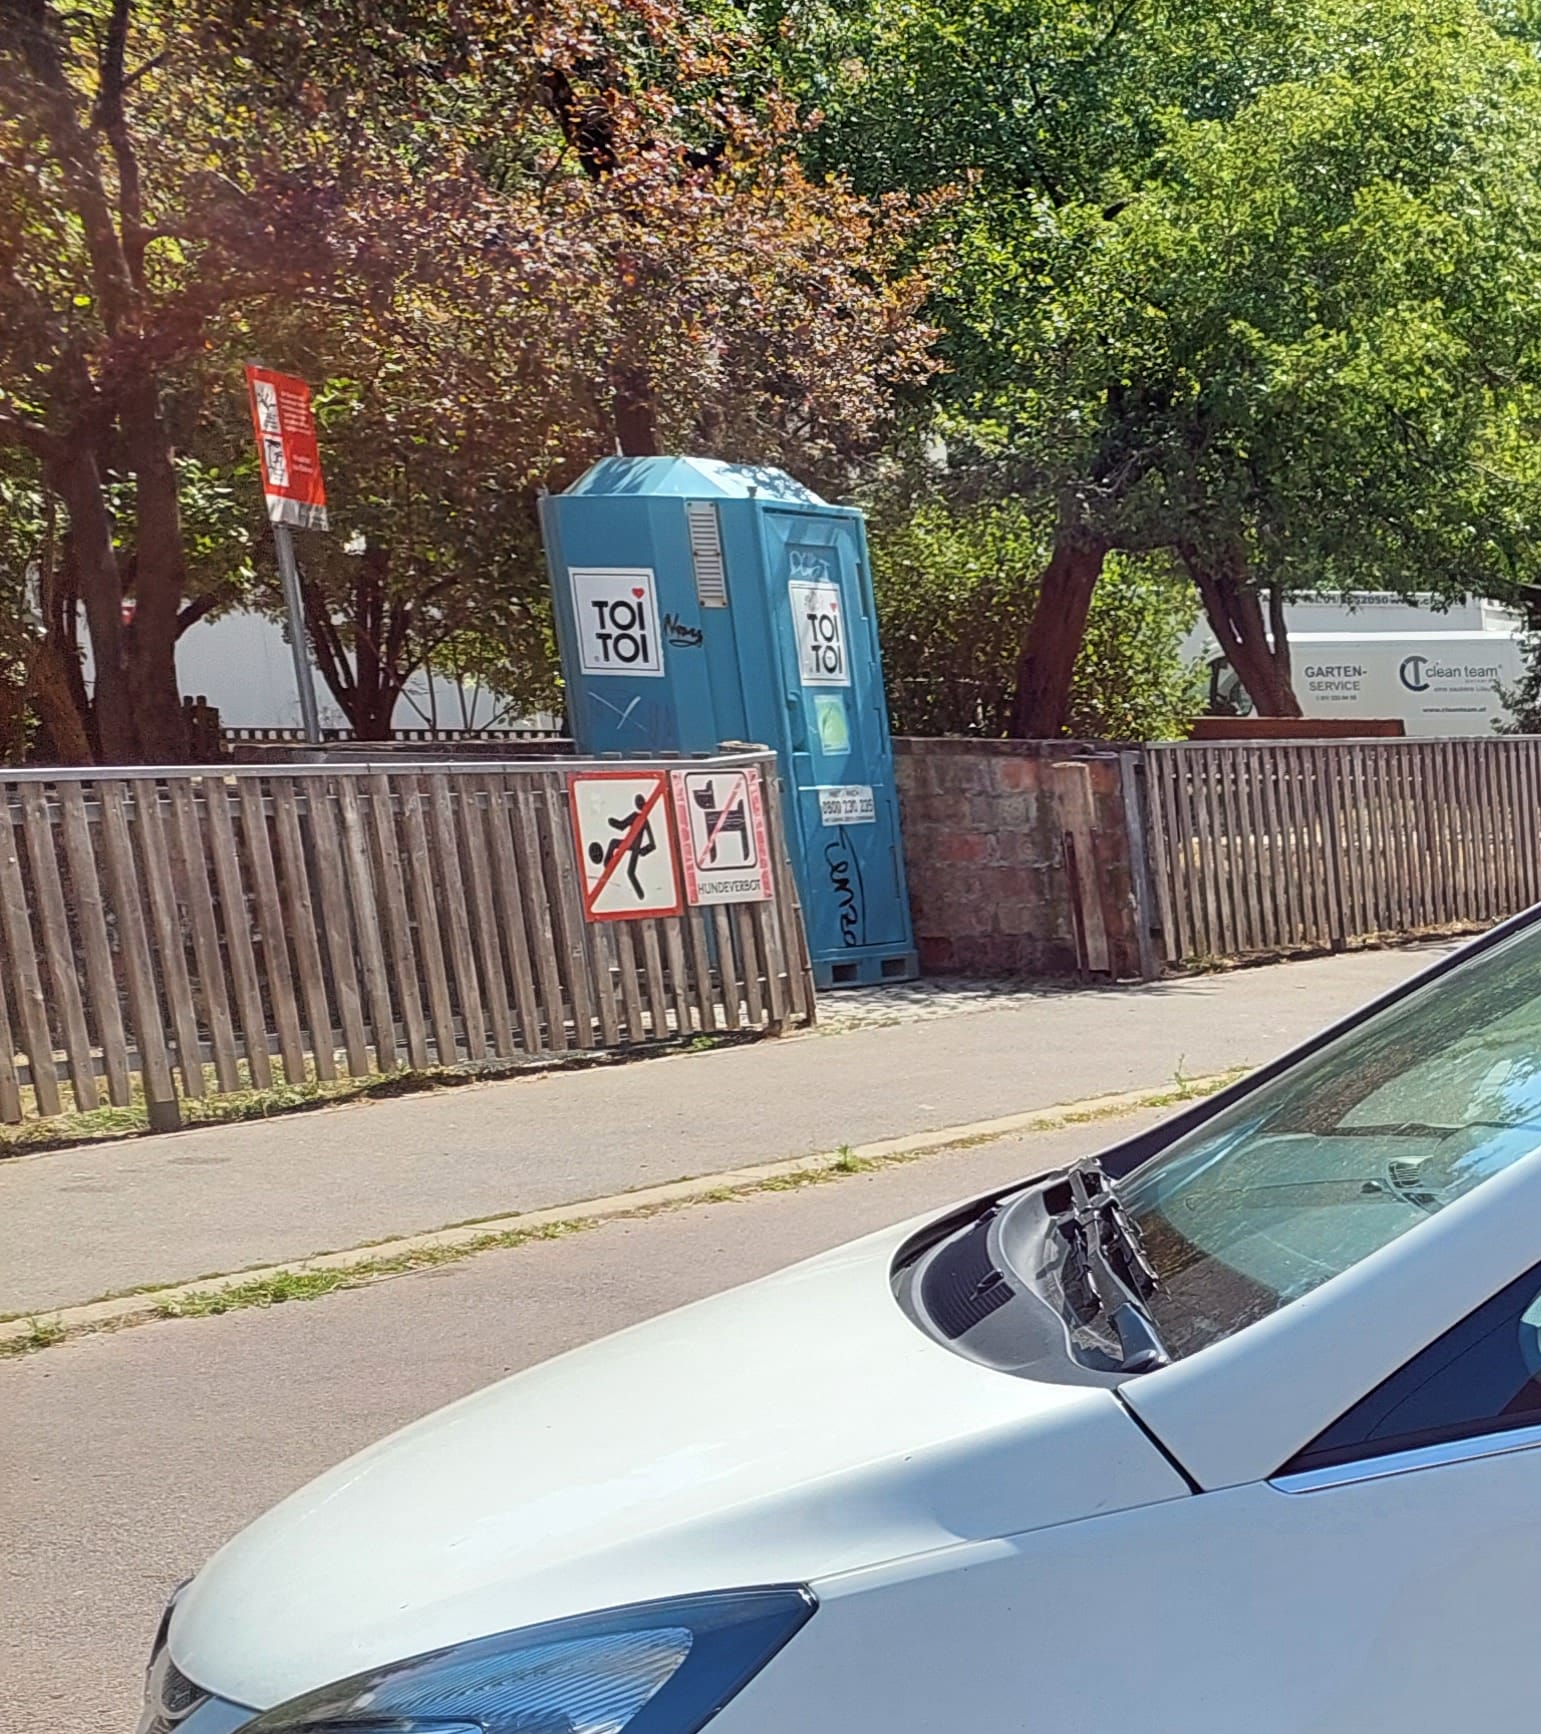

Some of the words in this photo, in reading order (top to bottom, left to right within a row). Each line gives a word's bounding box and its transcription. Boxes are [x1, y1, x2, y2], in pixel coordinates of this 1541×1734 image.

[591, 600, 646, 631] TOI
[806, 613, 840, 643] TOI
[595, 633, 650, 663] TOI
[811, 645, 843, 674] TOI
[1304, 665, 1368, 678] GARTEN-
[1425, 664, 1461, 678] clean
[1308, 680, 1361, 692] SERVICE
[698, 879, 761, 895] HUNDEVERBOT
